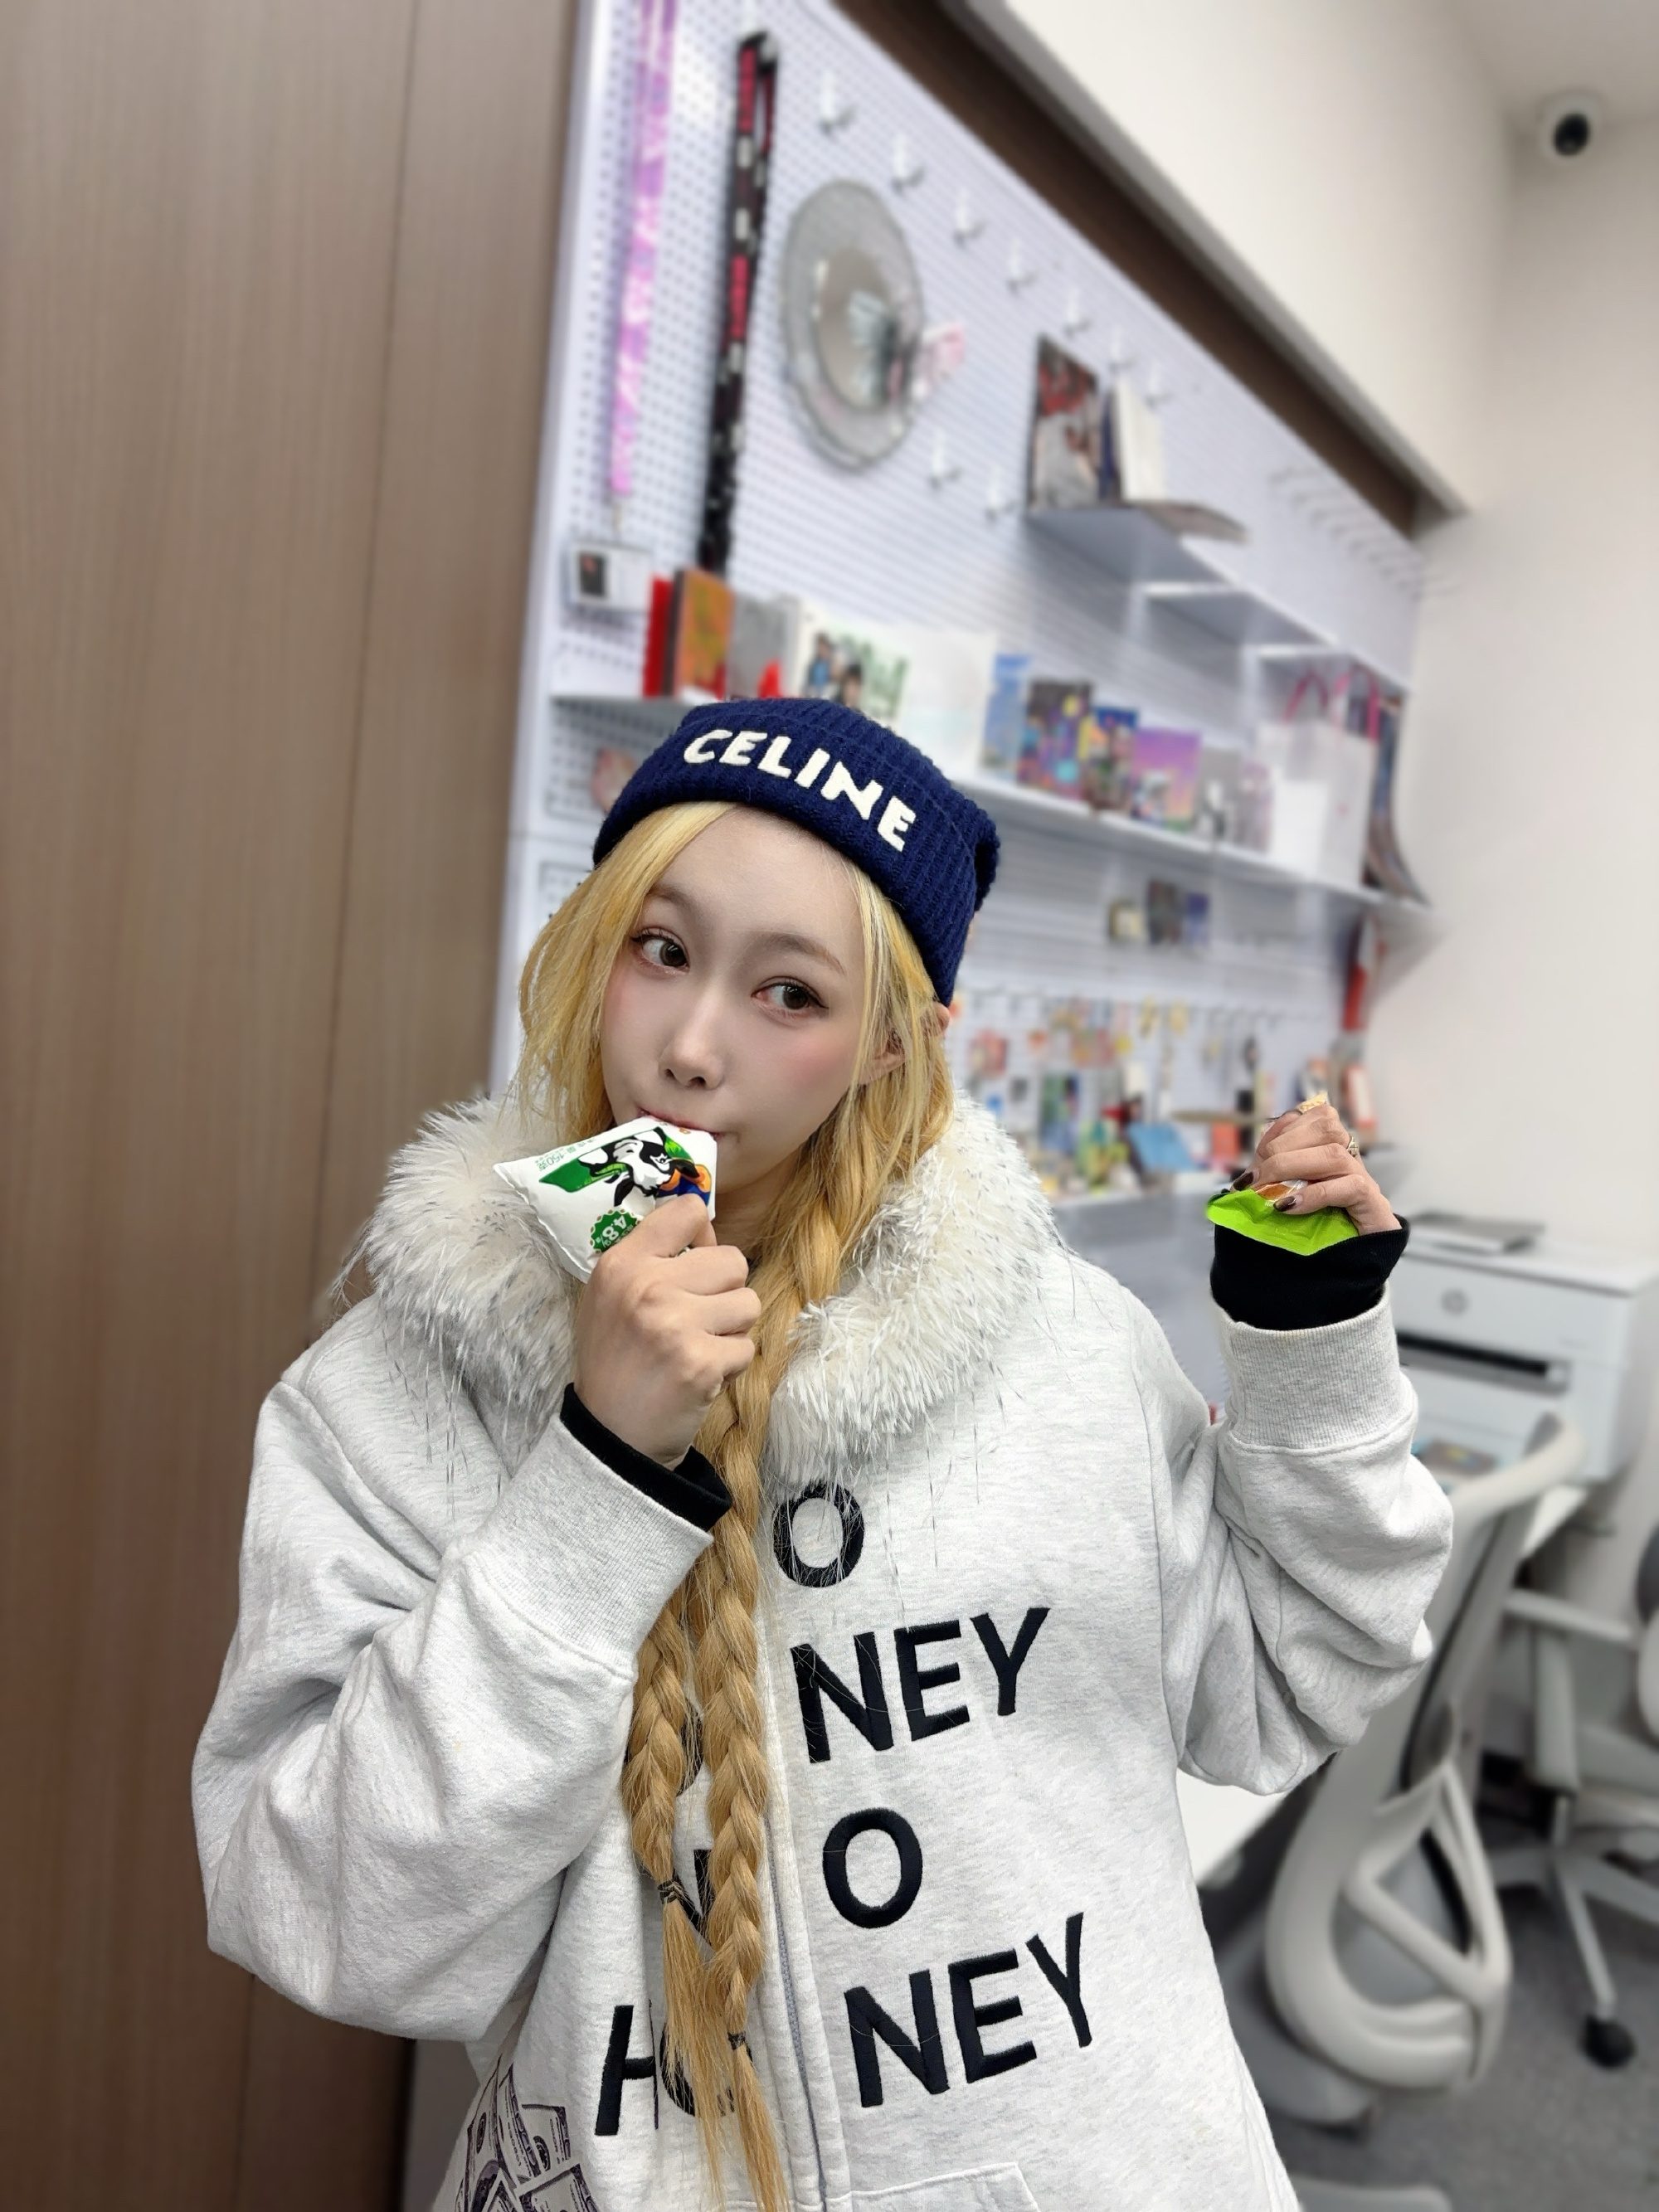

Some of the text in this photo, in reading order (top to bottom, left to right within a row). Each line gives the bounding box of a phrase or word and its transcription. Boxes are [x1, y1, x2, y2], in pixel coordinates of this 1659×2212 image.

[684, 729, 917, 852] CELINE
[790, 1607, 1051, 1763] NEY
[822, 1806, 923, 1929] O
[844, 1912, 1092, 2107] NEY
